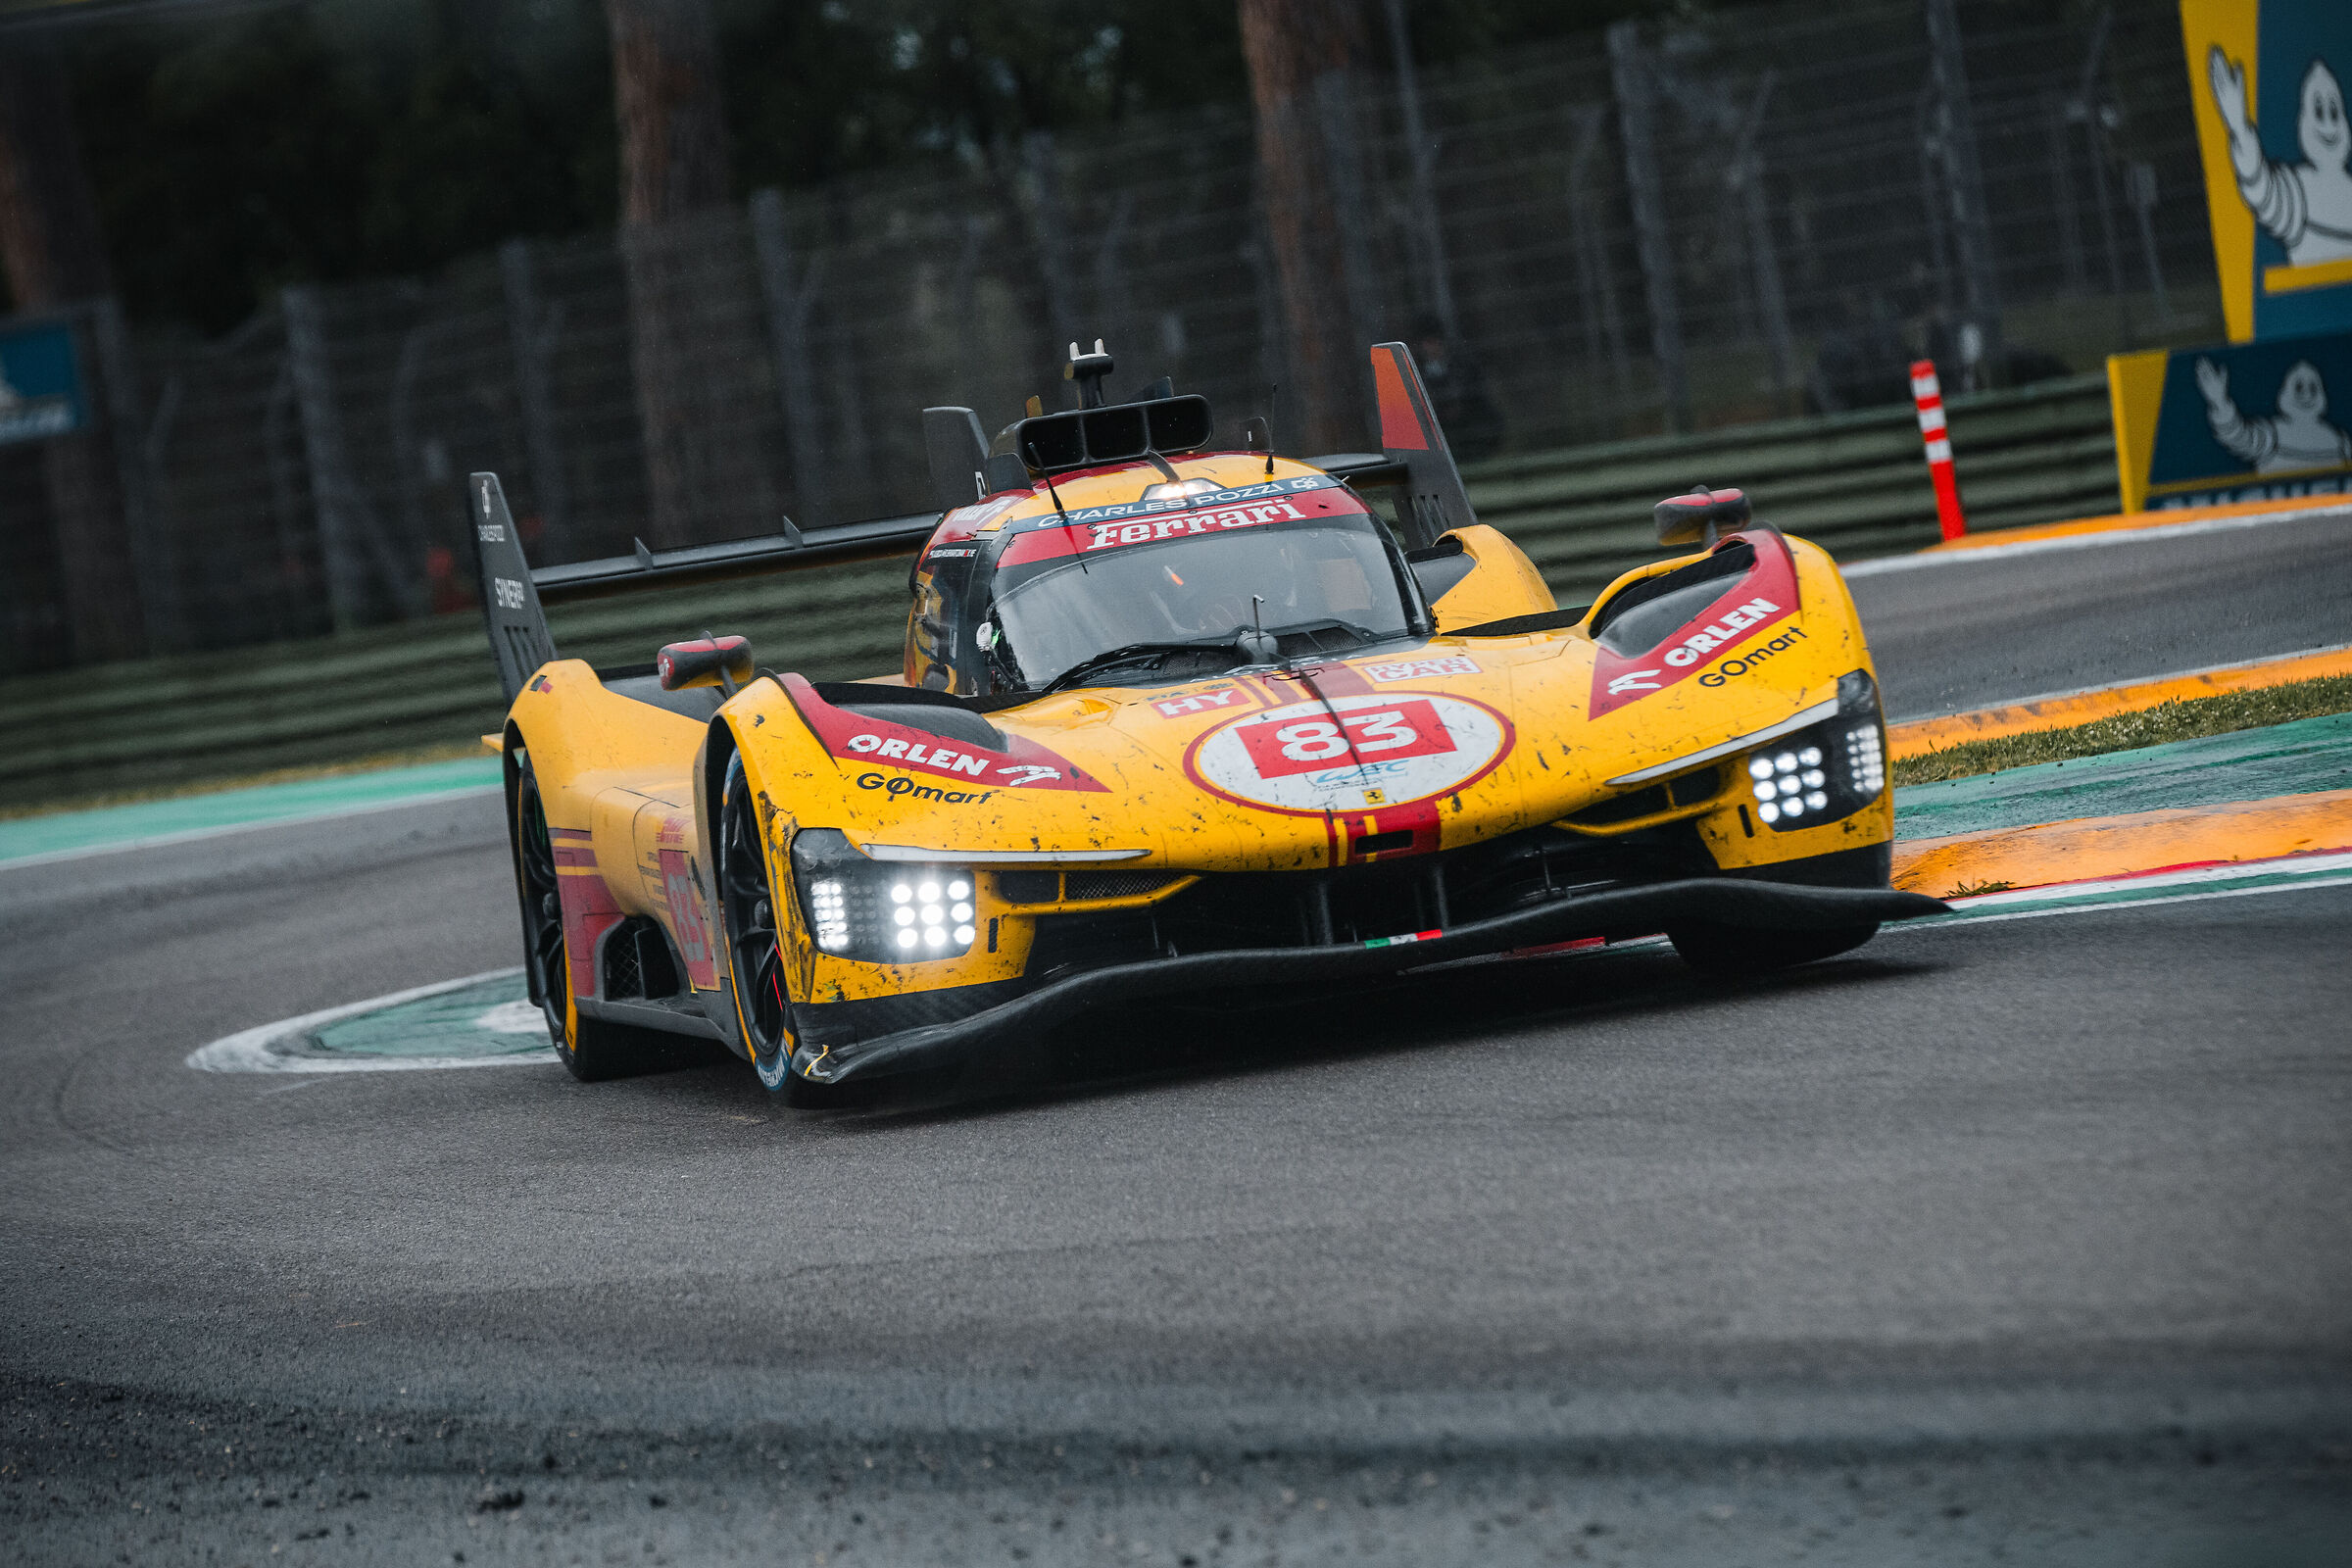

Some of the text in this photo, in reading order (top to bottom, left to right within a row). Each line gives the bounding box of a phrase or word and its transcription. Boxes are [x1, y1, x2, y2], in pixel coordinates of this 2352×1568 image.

[1038, 484, 1286, 528] CHARLES POZZI
[1086, 498, 1306, 550] Ferrari
[1664, 597, 1782, 667] ORLEN
[1698, 626, 1808, 688] GOmart
[1157, 690, 1233, 715] HY
[848, 734, 989, 776] ORLEN
[1275, 710, 1419, 761] 83
